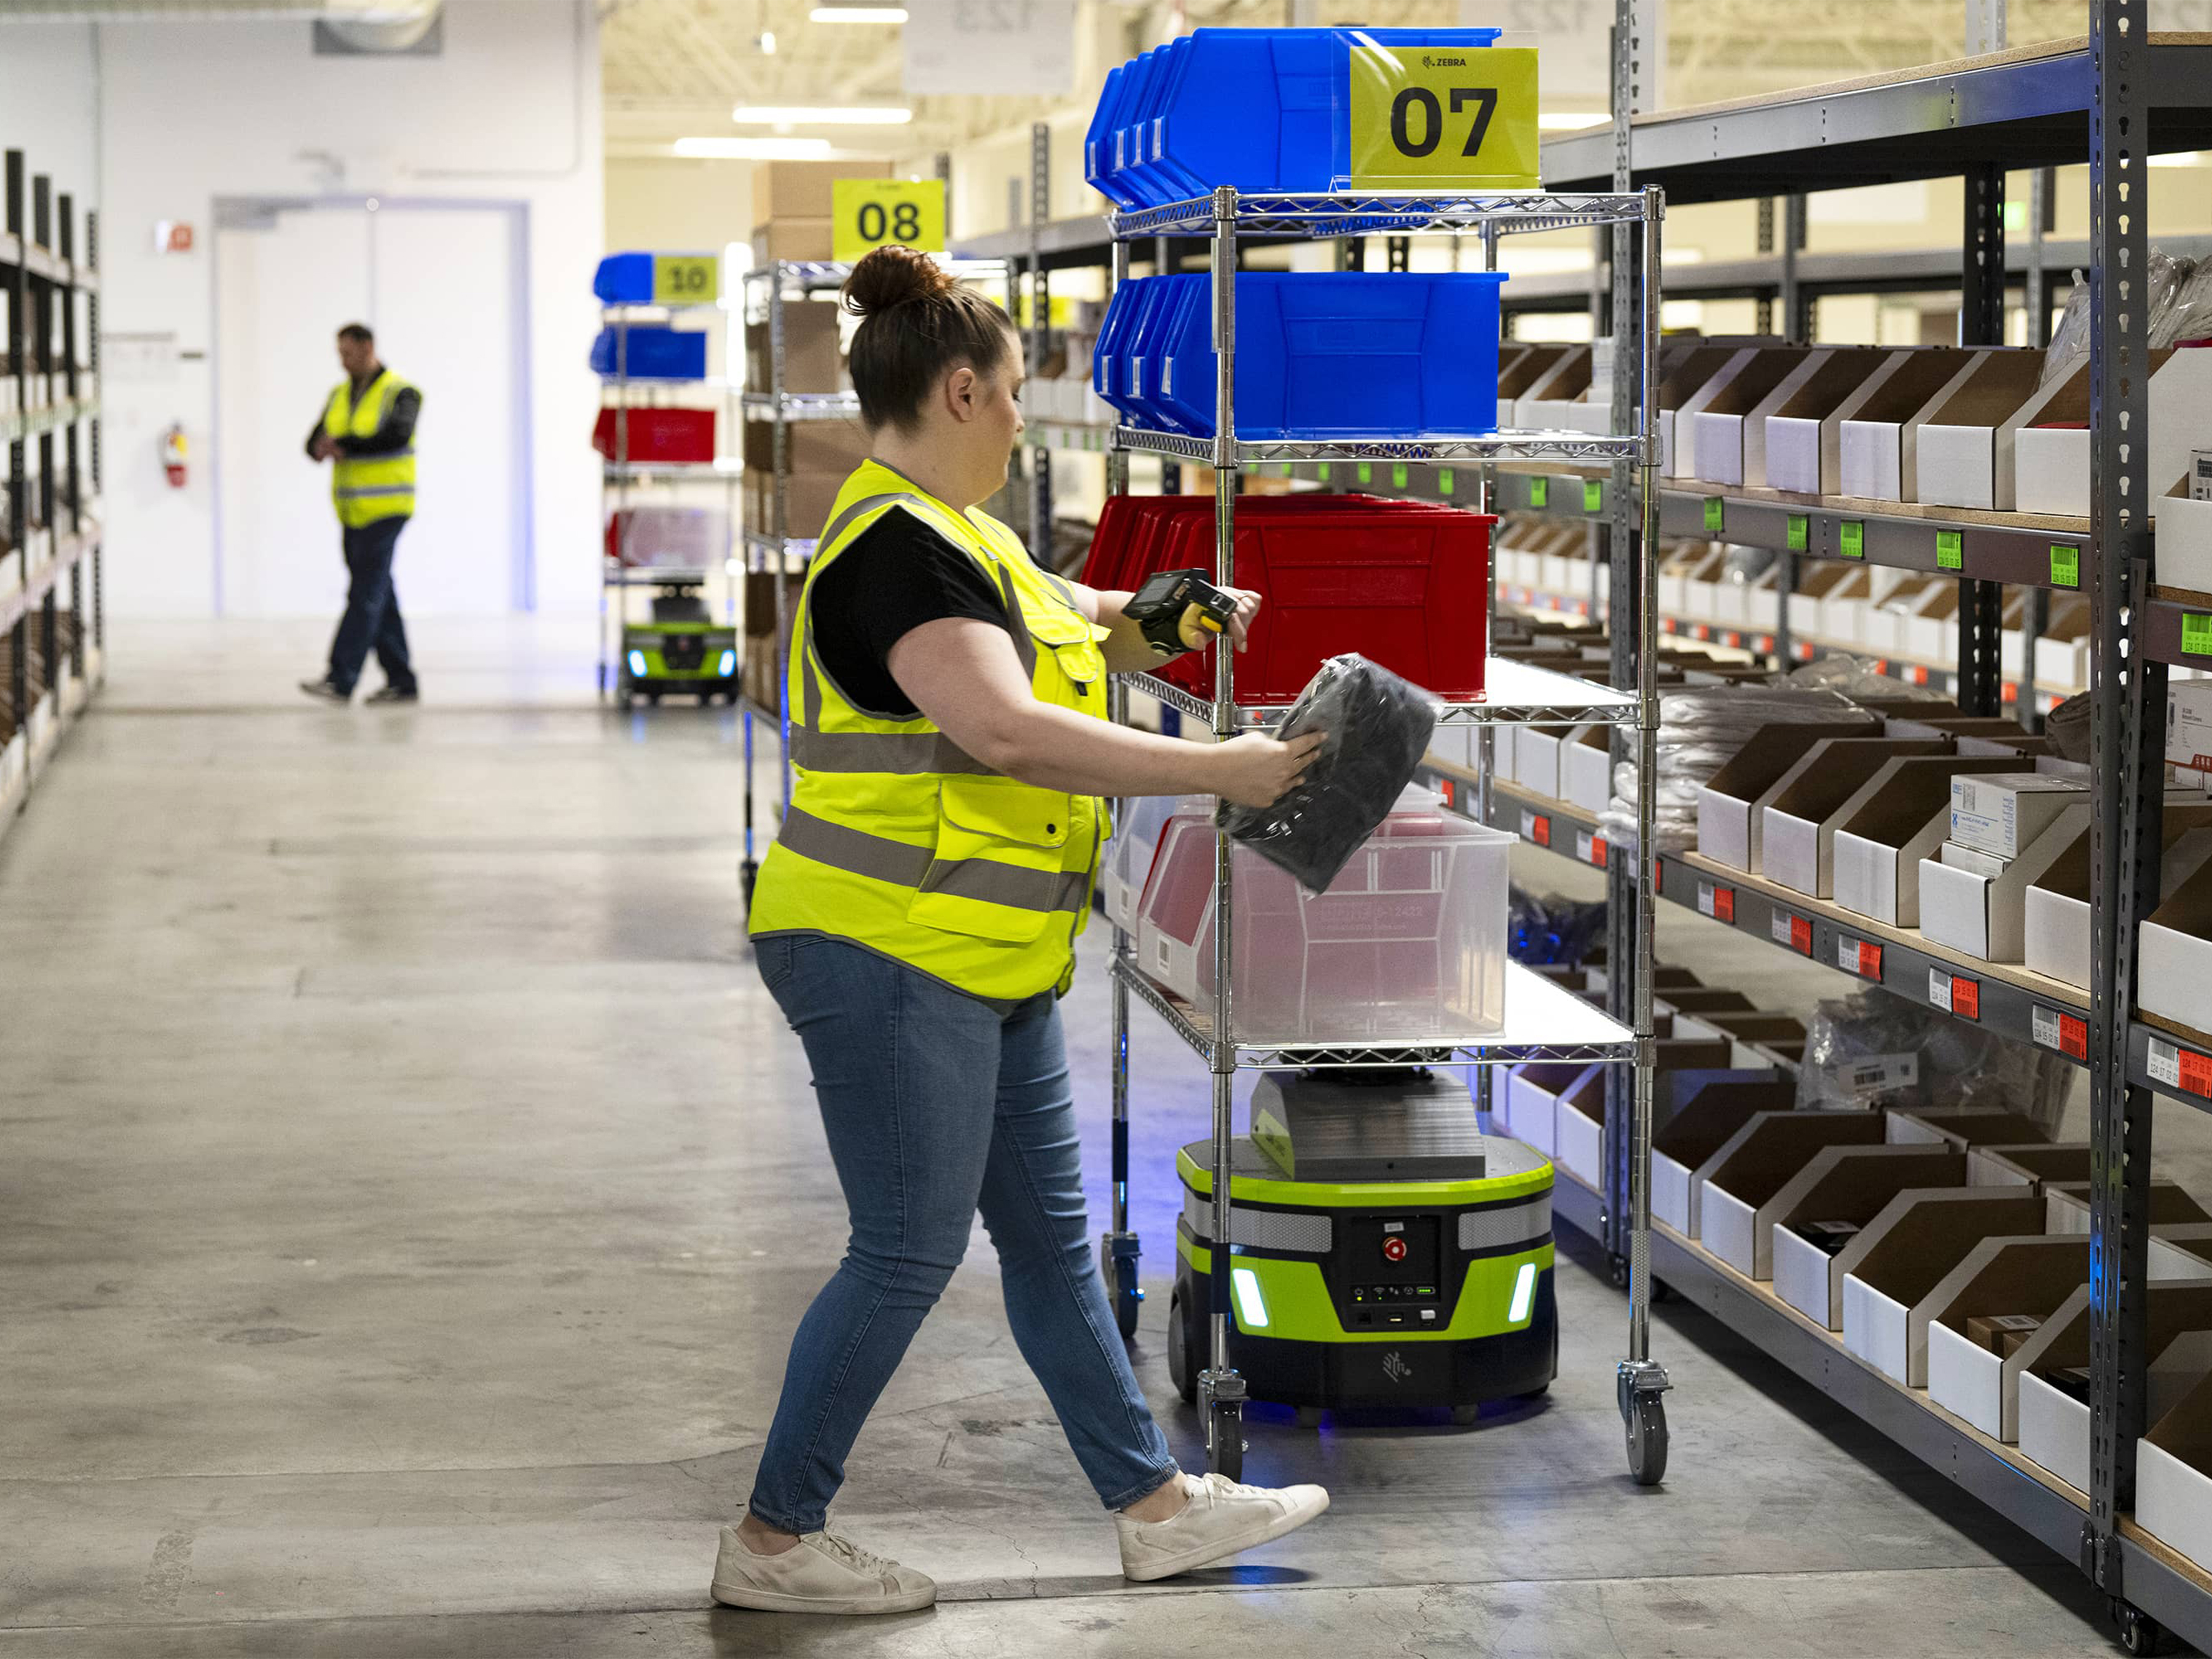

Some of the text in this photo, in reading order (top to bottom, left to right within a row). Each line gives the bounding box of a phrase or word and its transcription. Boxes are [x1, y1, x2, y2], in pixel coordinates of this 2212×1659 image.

[1437, 58, 1467, 67] ZEBRA
[1390, 87, 1497, 158] 07
[858, 202, 920, 242] 08
[670, 265, 708, 292] 10
